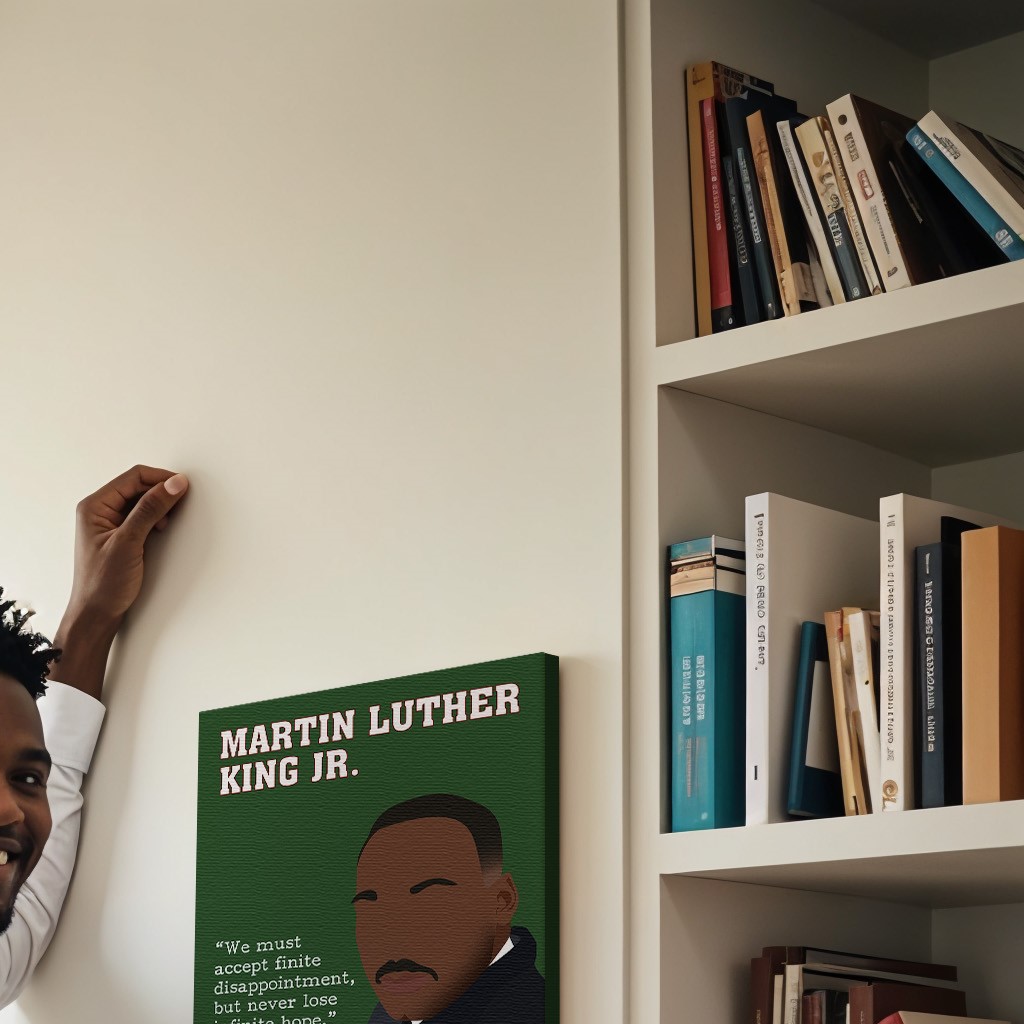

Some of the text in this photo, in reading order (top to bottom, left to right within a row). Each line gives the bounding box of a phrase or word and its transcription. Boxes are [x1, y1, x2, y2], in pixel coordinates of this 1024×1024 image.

[220, 682, 521, 760] MARTIN LUTHER
[219, 748, 359, 796] KING JR.
[215, 935, 302, 955] “We must
[214, 953, 322, 977] accept finite
[213, 971, 355, 997] disappointment,
[214, 993, 338, 1015] but never lose
